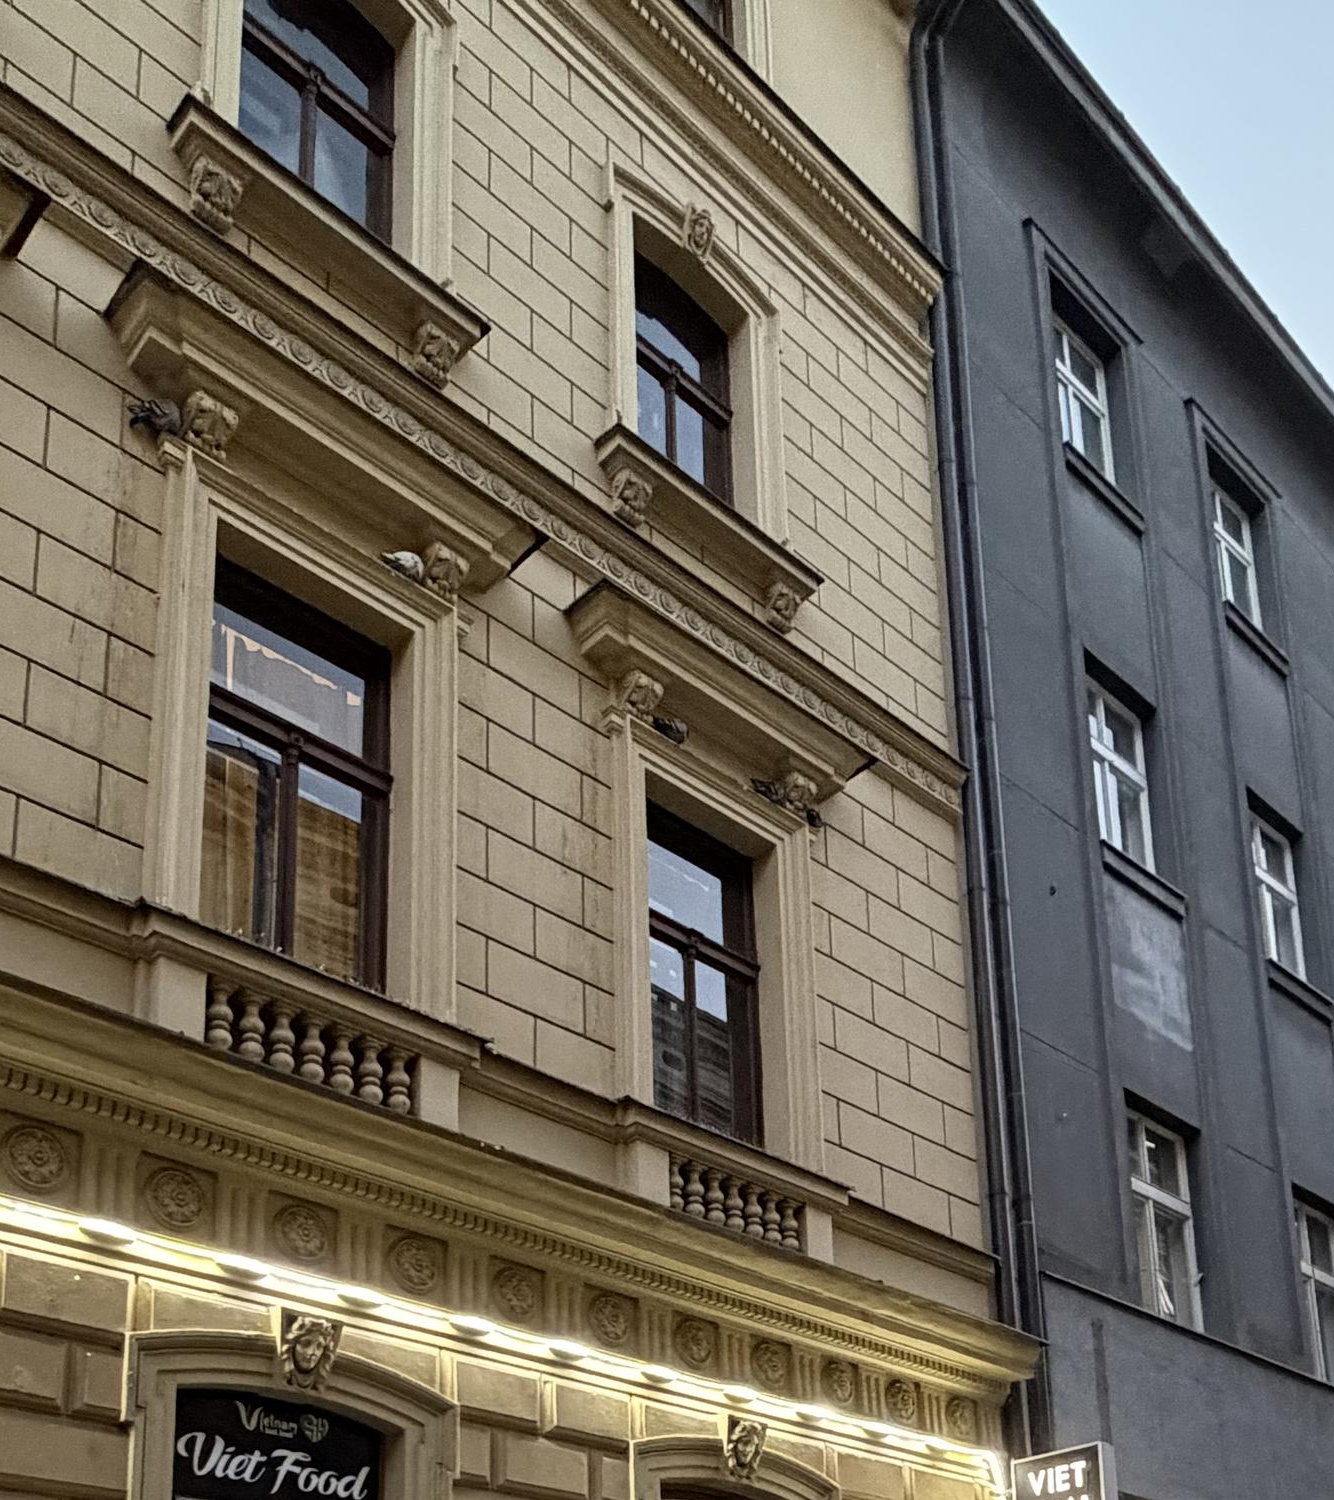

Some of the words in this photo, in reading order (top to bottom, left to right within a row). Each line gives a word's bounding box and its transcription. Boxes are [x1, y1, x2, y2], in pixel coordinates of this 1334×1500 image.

[235, 1400, 298, 1434] Vietnam
[176, 1432, 267, 1483] Viet
[269, 1449, 371, 1500] Food
[1027, 1460, 1087, 1496] VIET
